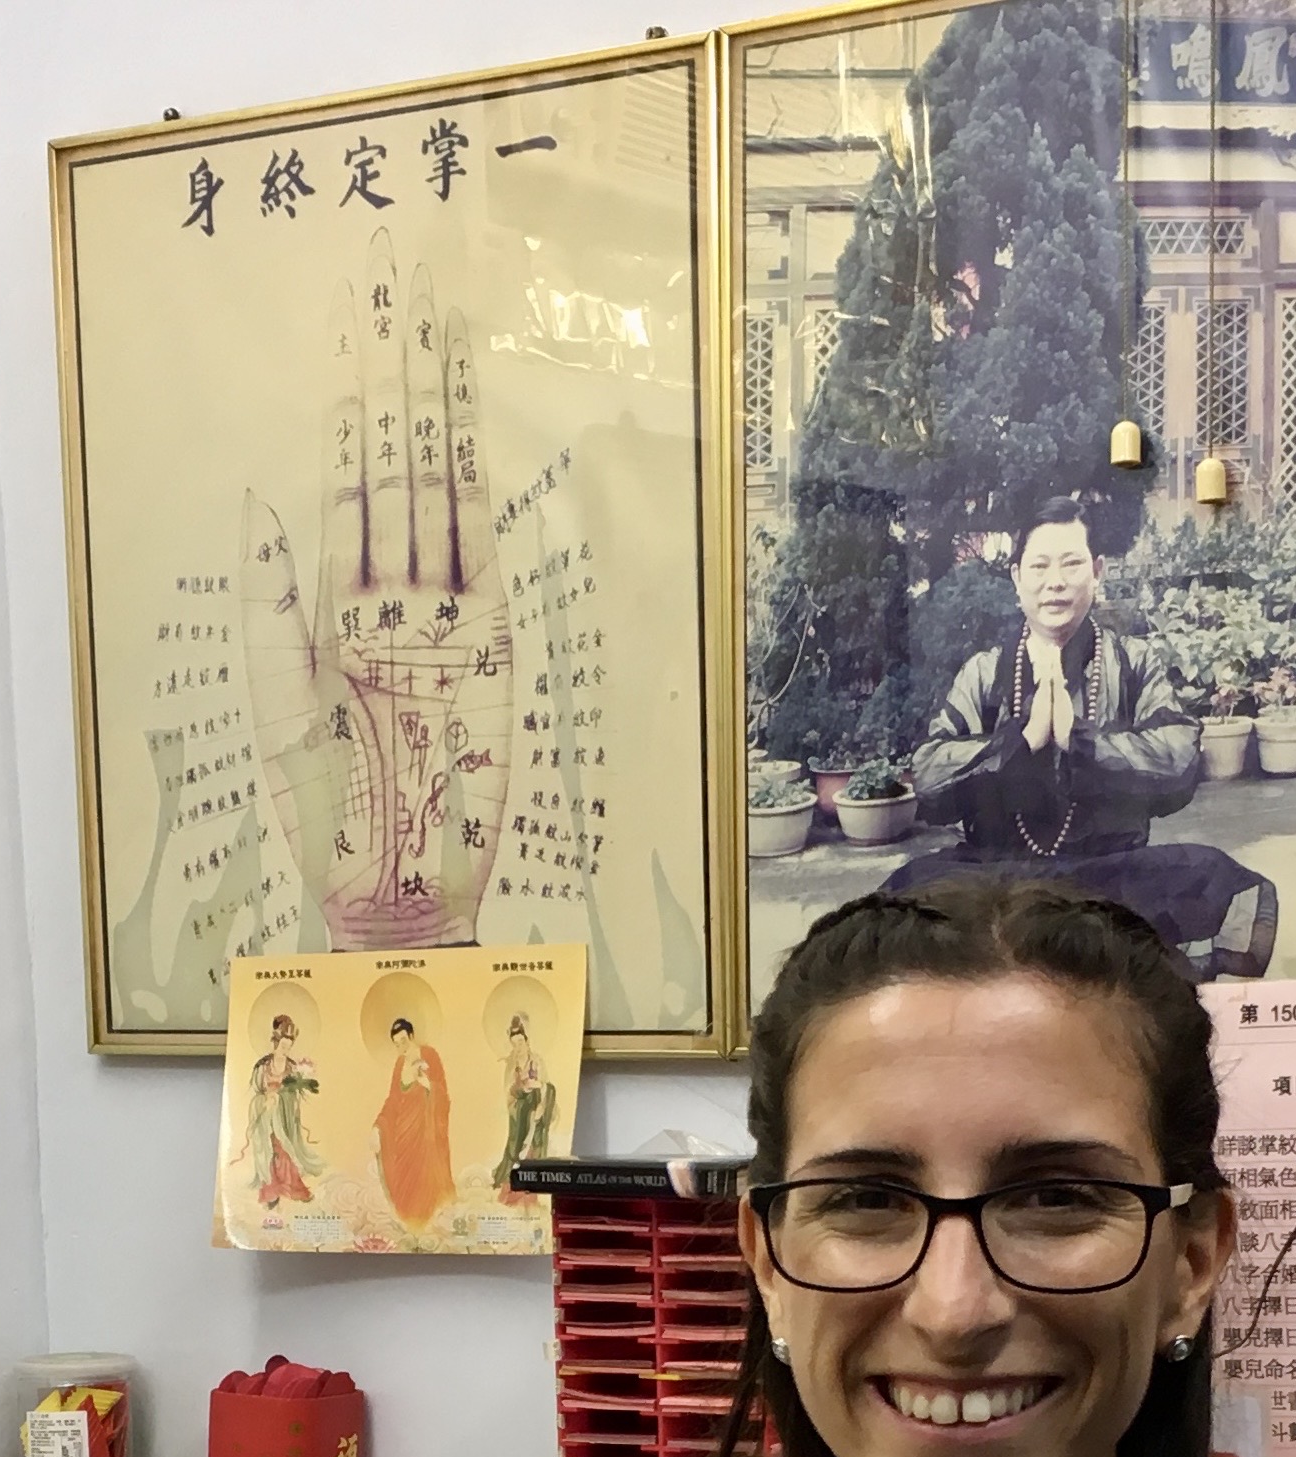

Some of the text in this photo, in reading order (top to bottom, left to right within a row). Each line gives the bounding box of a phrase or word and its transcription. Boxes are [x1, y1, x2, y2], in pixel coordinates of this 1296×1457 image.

[377, 411, 397, 467] 中年
[415, 416, 440, 467] 晚年
[1240, 1003, 1258, 1023] 第
[518, 1170, 538, 1182] THE
[540, 1171, 572, 1183] TIMES
[576, 1173, 607, 1185] ATLAS
[634, 1175, 667, 1187] WORLD
